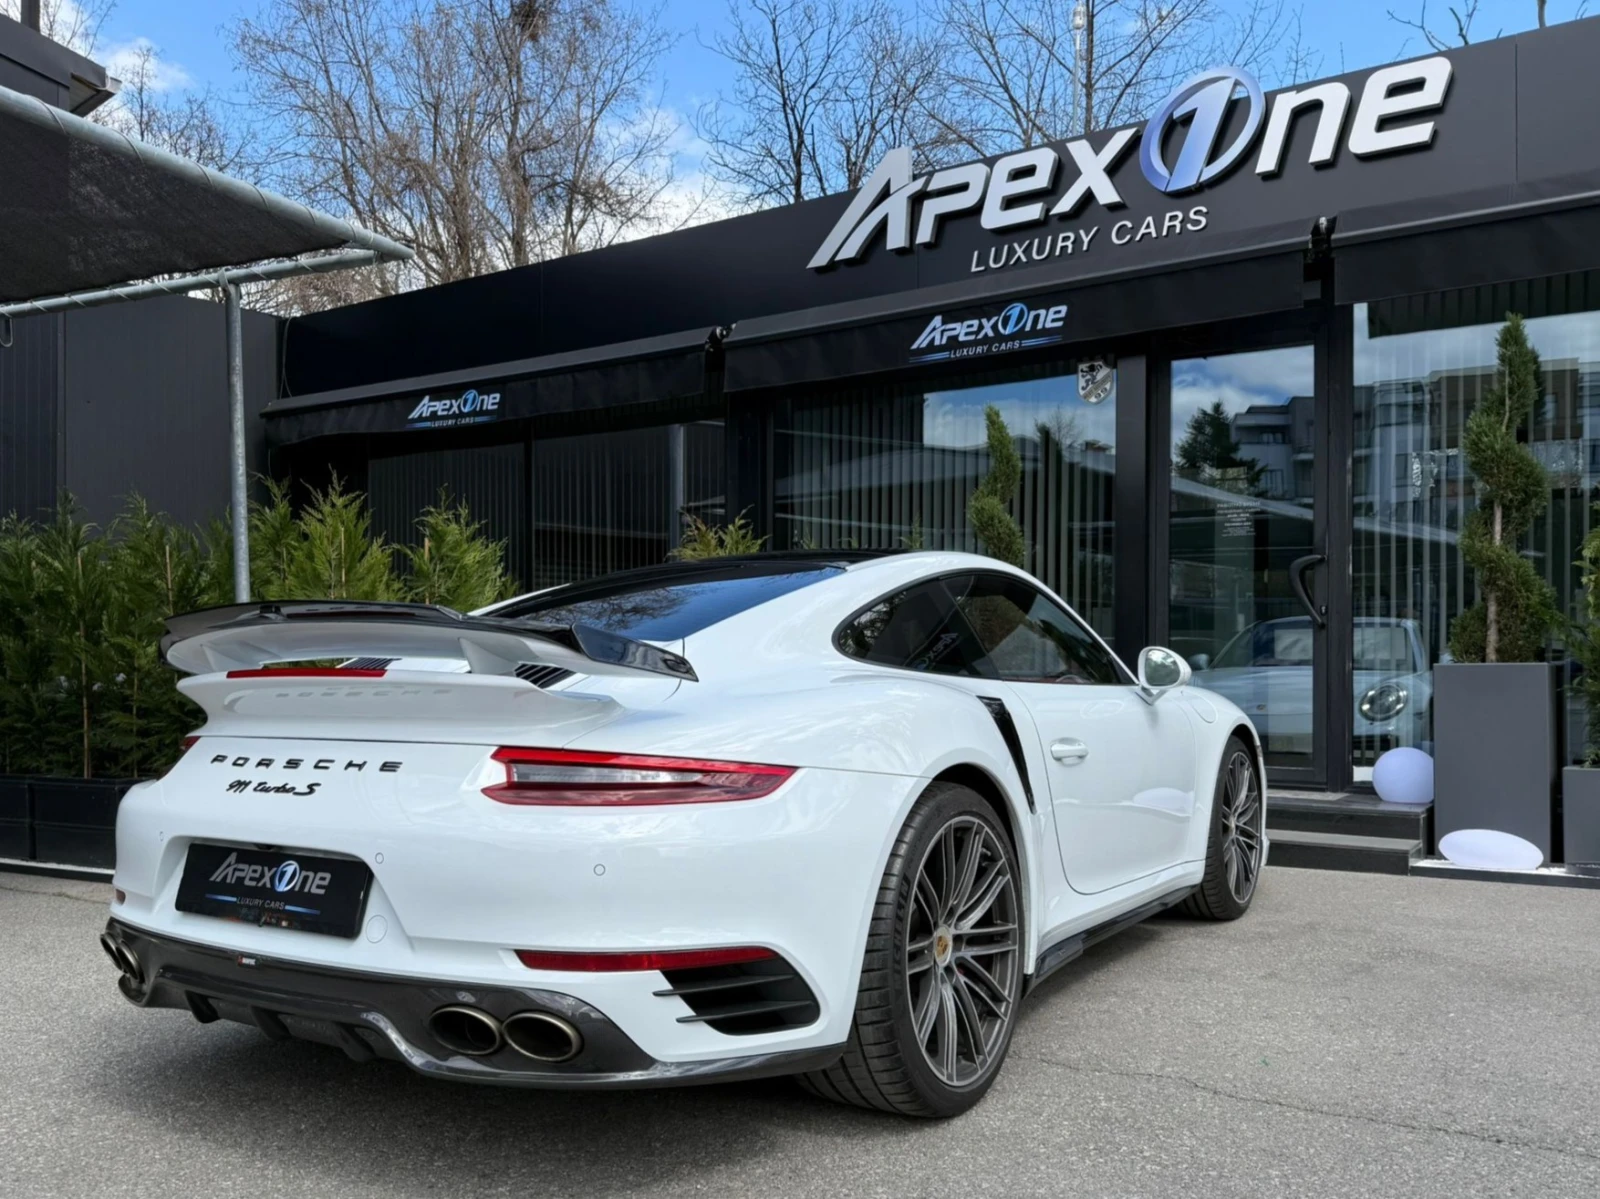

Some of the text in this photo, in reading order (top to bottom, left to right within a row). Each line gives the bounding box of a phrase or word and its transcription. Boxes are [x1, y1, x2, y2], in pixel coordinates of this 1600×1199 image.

[970, 206, 1208, 273] LUXURY CARS
[950, 339, 1020, 359] LUXURY CARS
[431, 417, 475, 428] LUXURY CARS
[210, 753, 404, 773] PORSCHE
[226, 779, 322, 797] 911 turbo S
[236, 896, 285, 911] LUXURY CARS
